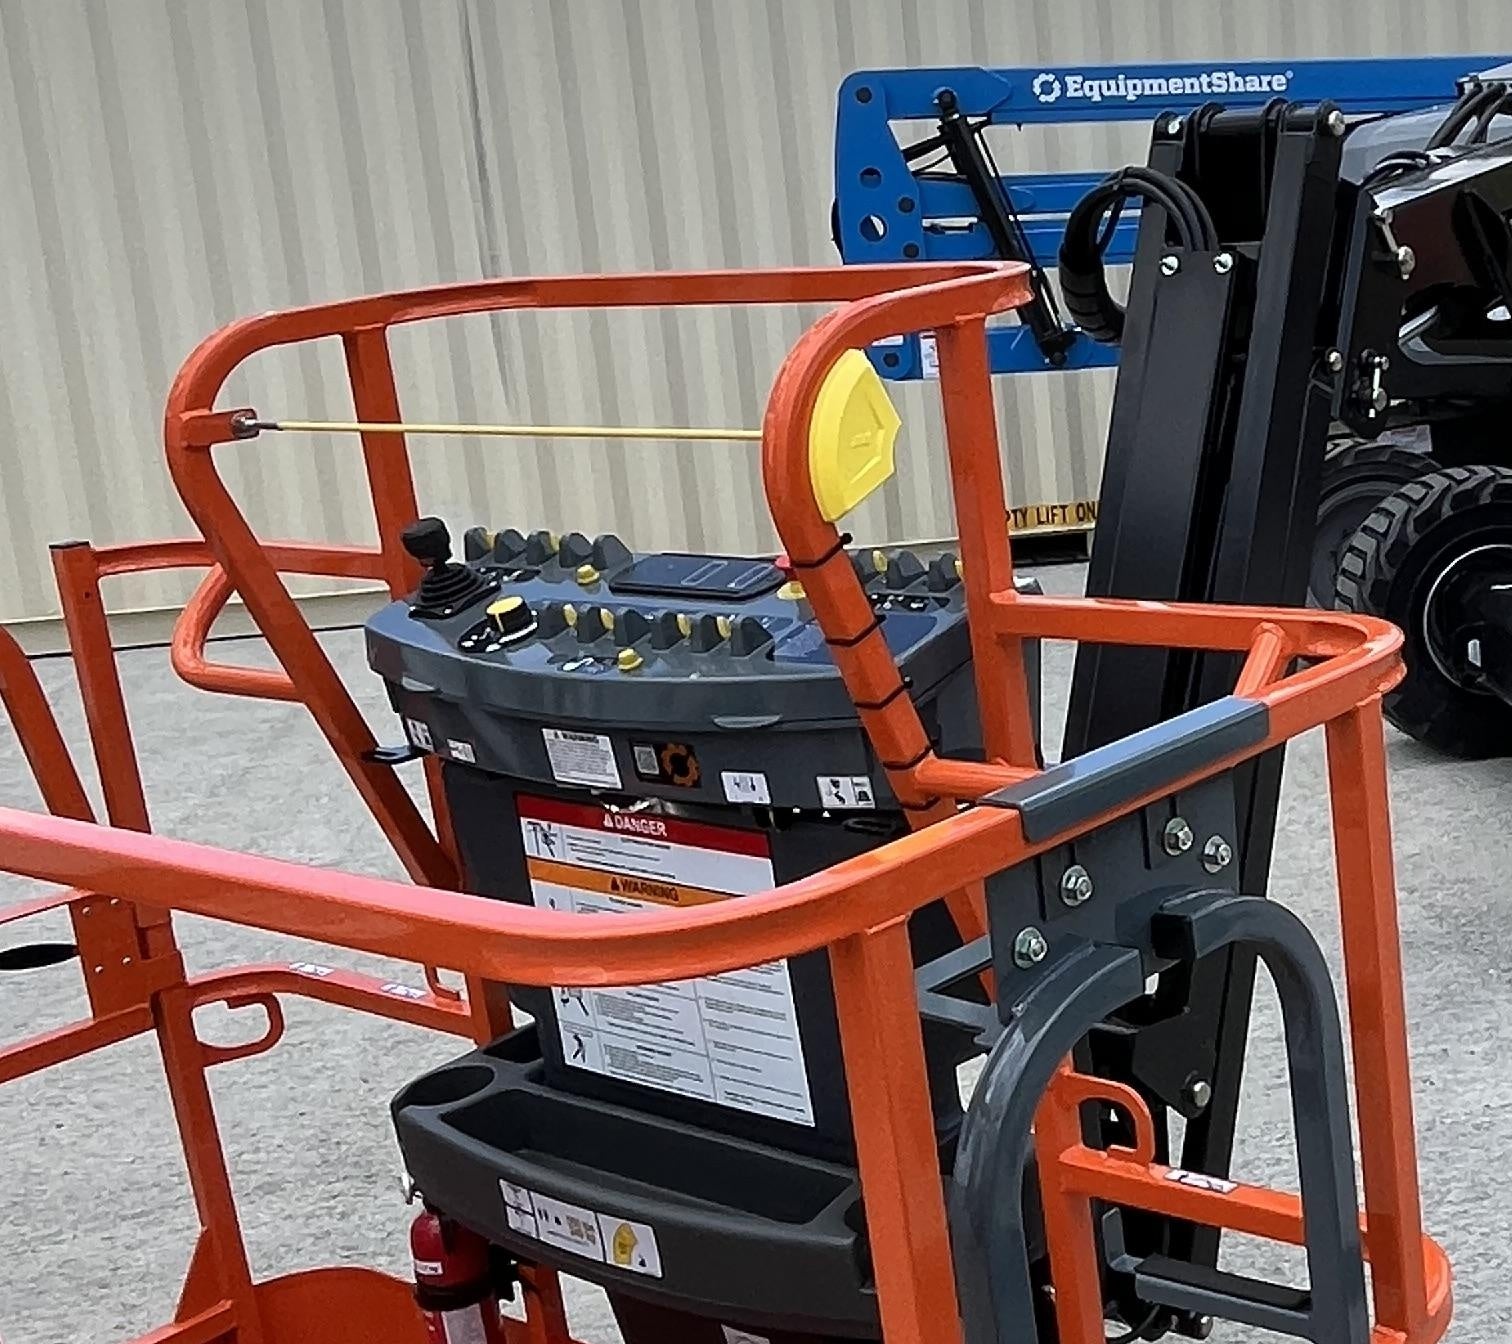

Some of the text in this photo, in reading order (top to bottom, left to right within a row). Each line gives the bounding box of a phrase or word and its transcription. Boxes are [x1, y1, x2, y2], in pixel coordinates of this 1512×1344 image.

[1065, 72, 1288, 100] EquipmentShare
[1036, 505, 1068, 525] LIFT
[613, 813, 668, 838] DANGER
[619, 877, 680, 902] WARNING
